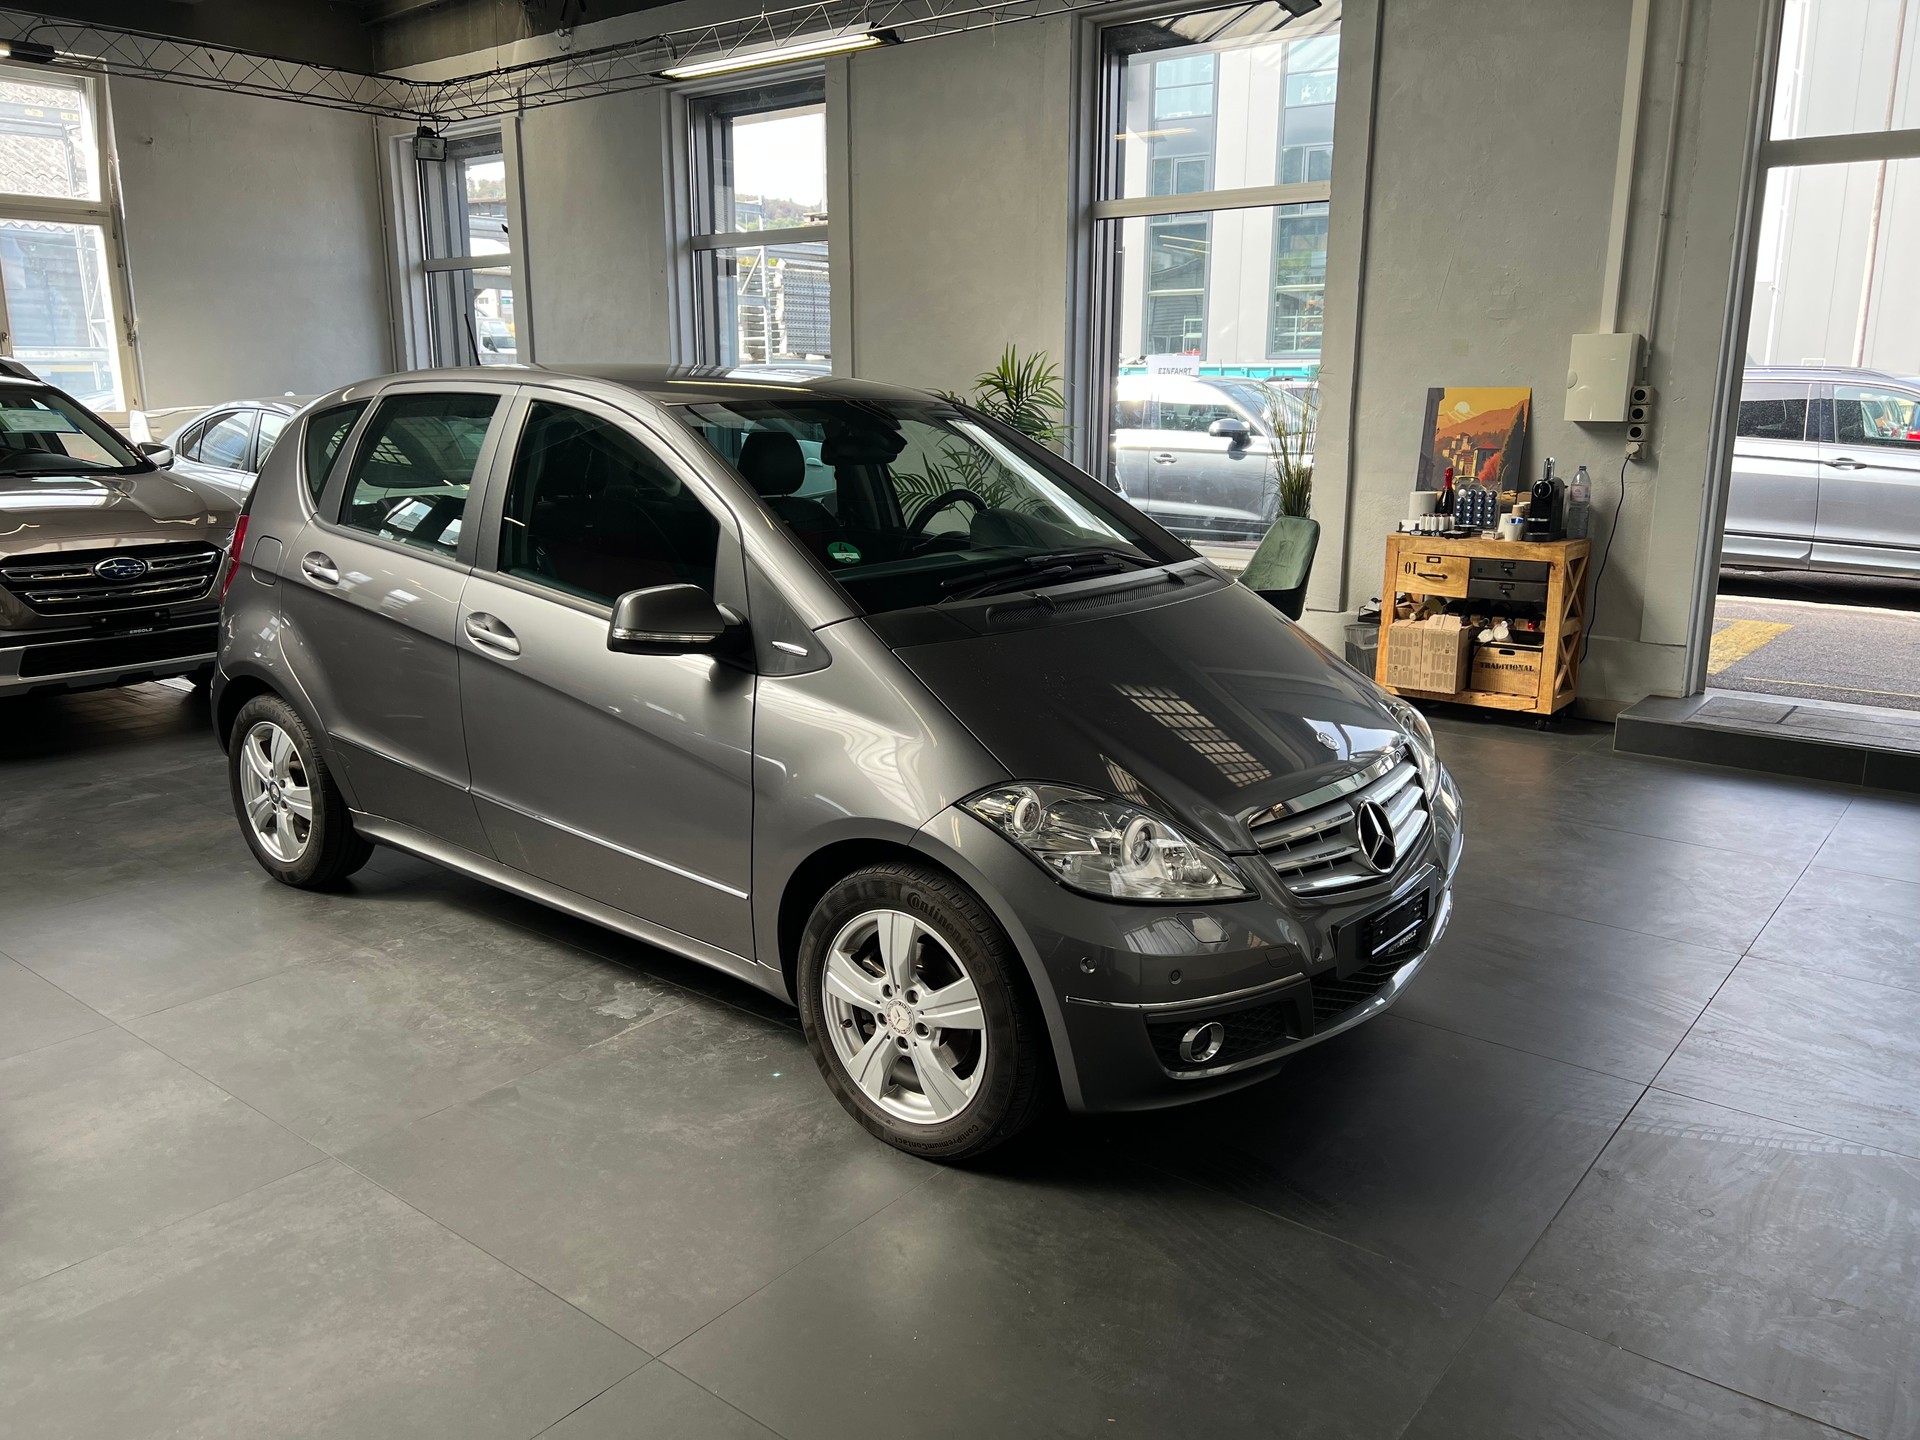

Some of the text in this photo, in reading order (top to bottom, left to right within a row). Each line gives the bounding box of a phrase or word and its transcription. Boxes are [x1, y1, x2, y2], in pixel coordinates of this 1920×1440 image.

[1157, 367, 1193, 376] EINFAHRT
[838, 542, 849, 553] 4
[1480, 661, 1535, 672] TRADITIONAL
[906, 892, 978, 961] Continental
